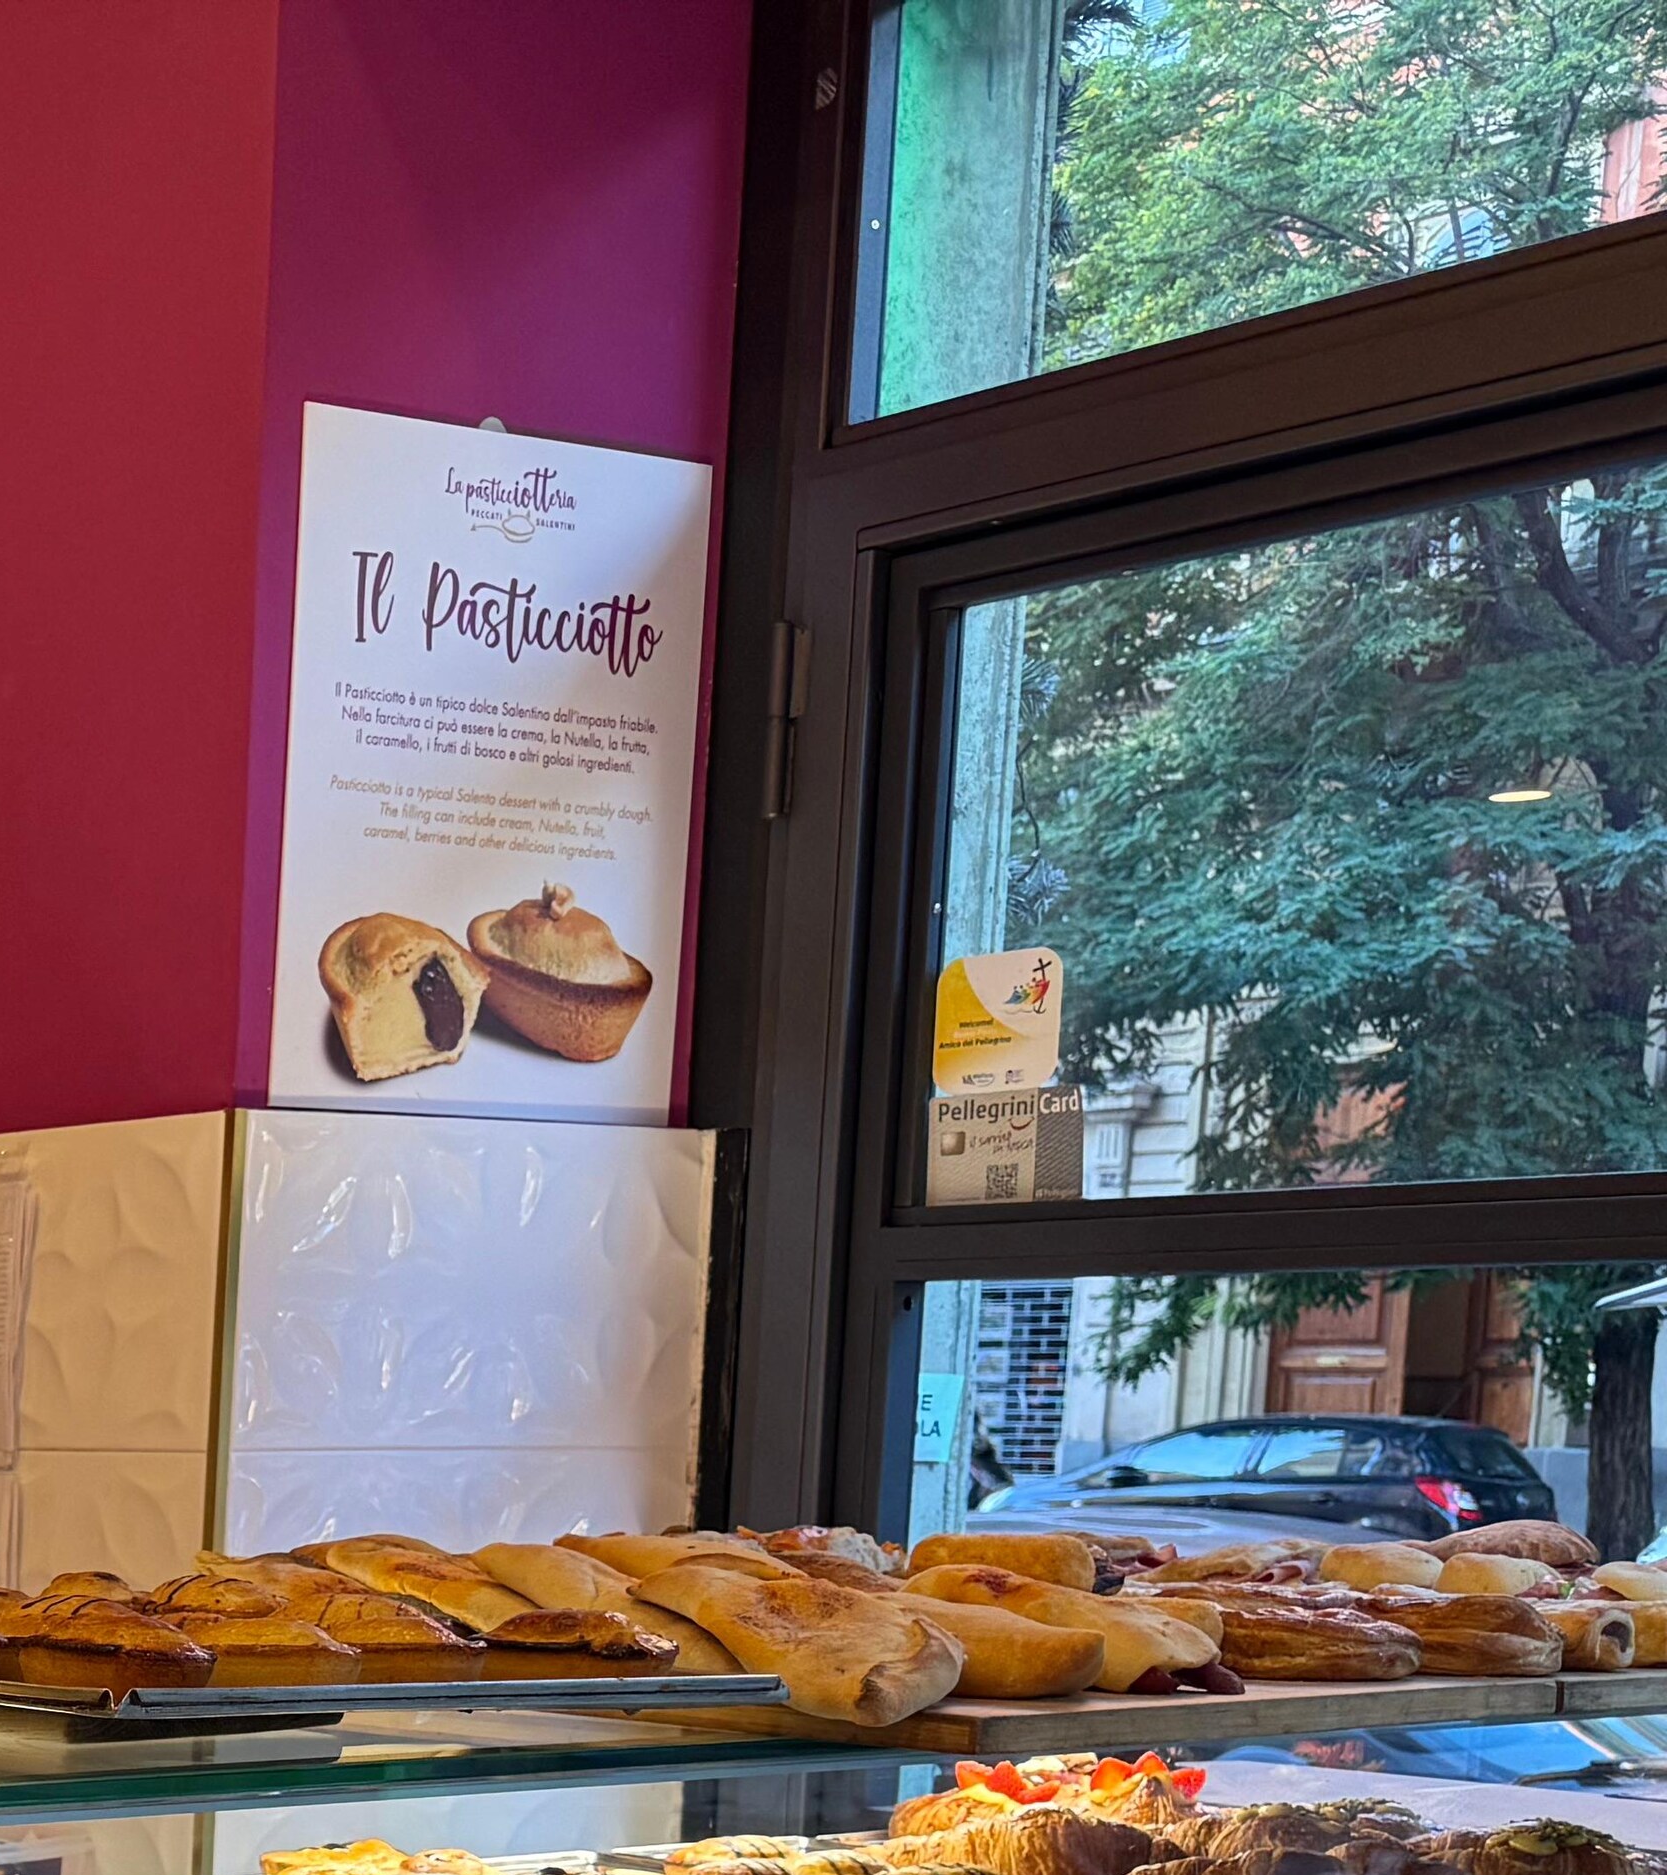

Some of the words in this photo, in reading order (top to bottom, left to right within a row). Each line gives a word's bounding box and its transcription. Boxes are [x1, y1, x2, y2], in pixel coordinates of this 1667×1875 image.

[445, 467, 463, 494] La
[466, 467, 576, 512] pasticciotteria
[471, 509, 503, 521] PECCATI
[536, 518, 576, 531] SALENTINI
[352, 551, 395, 643] Il
[422, 561, 663, 677] Pasticciotto
[335, 682, 341, 697] Il
[345, 684, 406, 704] Pasticciotto
[419, 697, 433, 707] un
[436, 696, 466, 713] tipico
[469, 698, 498, 716] dolce
[502, 701, 550, 722] Salentino
[554, 707, 616, 731] dall'impasto
[620, 715, 658, 734] friabile.
[341, 706, 372, 722] Nella
[375, 708, 421, 728] farcitura
[424, 716, 434, 729] ci
[437, 720, 458, 734] può
[461, 724, 494, 737] essere
[498, 723, 508, 738] la
[511, 729, 547, 744] crema,
[551, 729, 560, 744] la
[564, 732, 605, 751] Nutella,
[608, 735, 618, 751] la
[621, 736, 650, 756] frutta,
[355, 729, 362, 744] il
[365, 732, 423, 753] caramello,
[434, 736, 457, 755] frutti
[460, 740, 470, 756] di
[474, 742, 506, 761] bosco
[519, 747, 539, 763] altri
[543, 751, 574, 769] golosi
[577, 754, 635, 774] ingredienti.
[330, 774, 392, 796] Pasticciotto
[395, 782, 403, 796] is
[417, 785, 454, 802] typical
[457, 788, 496, 806] Salento
[499, 793, 537, 810] dessert
[539, 797, 561, 812] with
[574, 800, 616, 820] crumbly
[618, 805, 653, 825] dough.
[380, 801, 398, 818] The
[402, 803, 431, 824] filling
[434, 811, 454, 823] can
[458, 811, 496, 828] include
[498, 817, 535, 833] cream,
[538, 819, 579, 838] Nutella,
[582, 821, 606, 840] fruit,
[363, 826, 411, 842] caramel,
[414, 829, 451, 845] berries
[454, 831, 476, 848] and
[478, 834, 506, 850] other
[508, 837, 555, 855] delicious
[557, 842, 616, 861] ingredients.
[938, 1039, 960, 1050] Amico
[962, 1038, 973, 1048] del
[975, 1035, 1012, 1047] Pellegrino
[959, 1018, 994, 1029] Welcome!
[938, 1095, 1035, 1124] Pellegrini
[1039, 1089, 1080, 1114] Card
